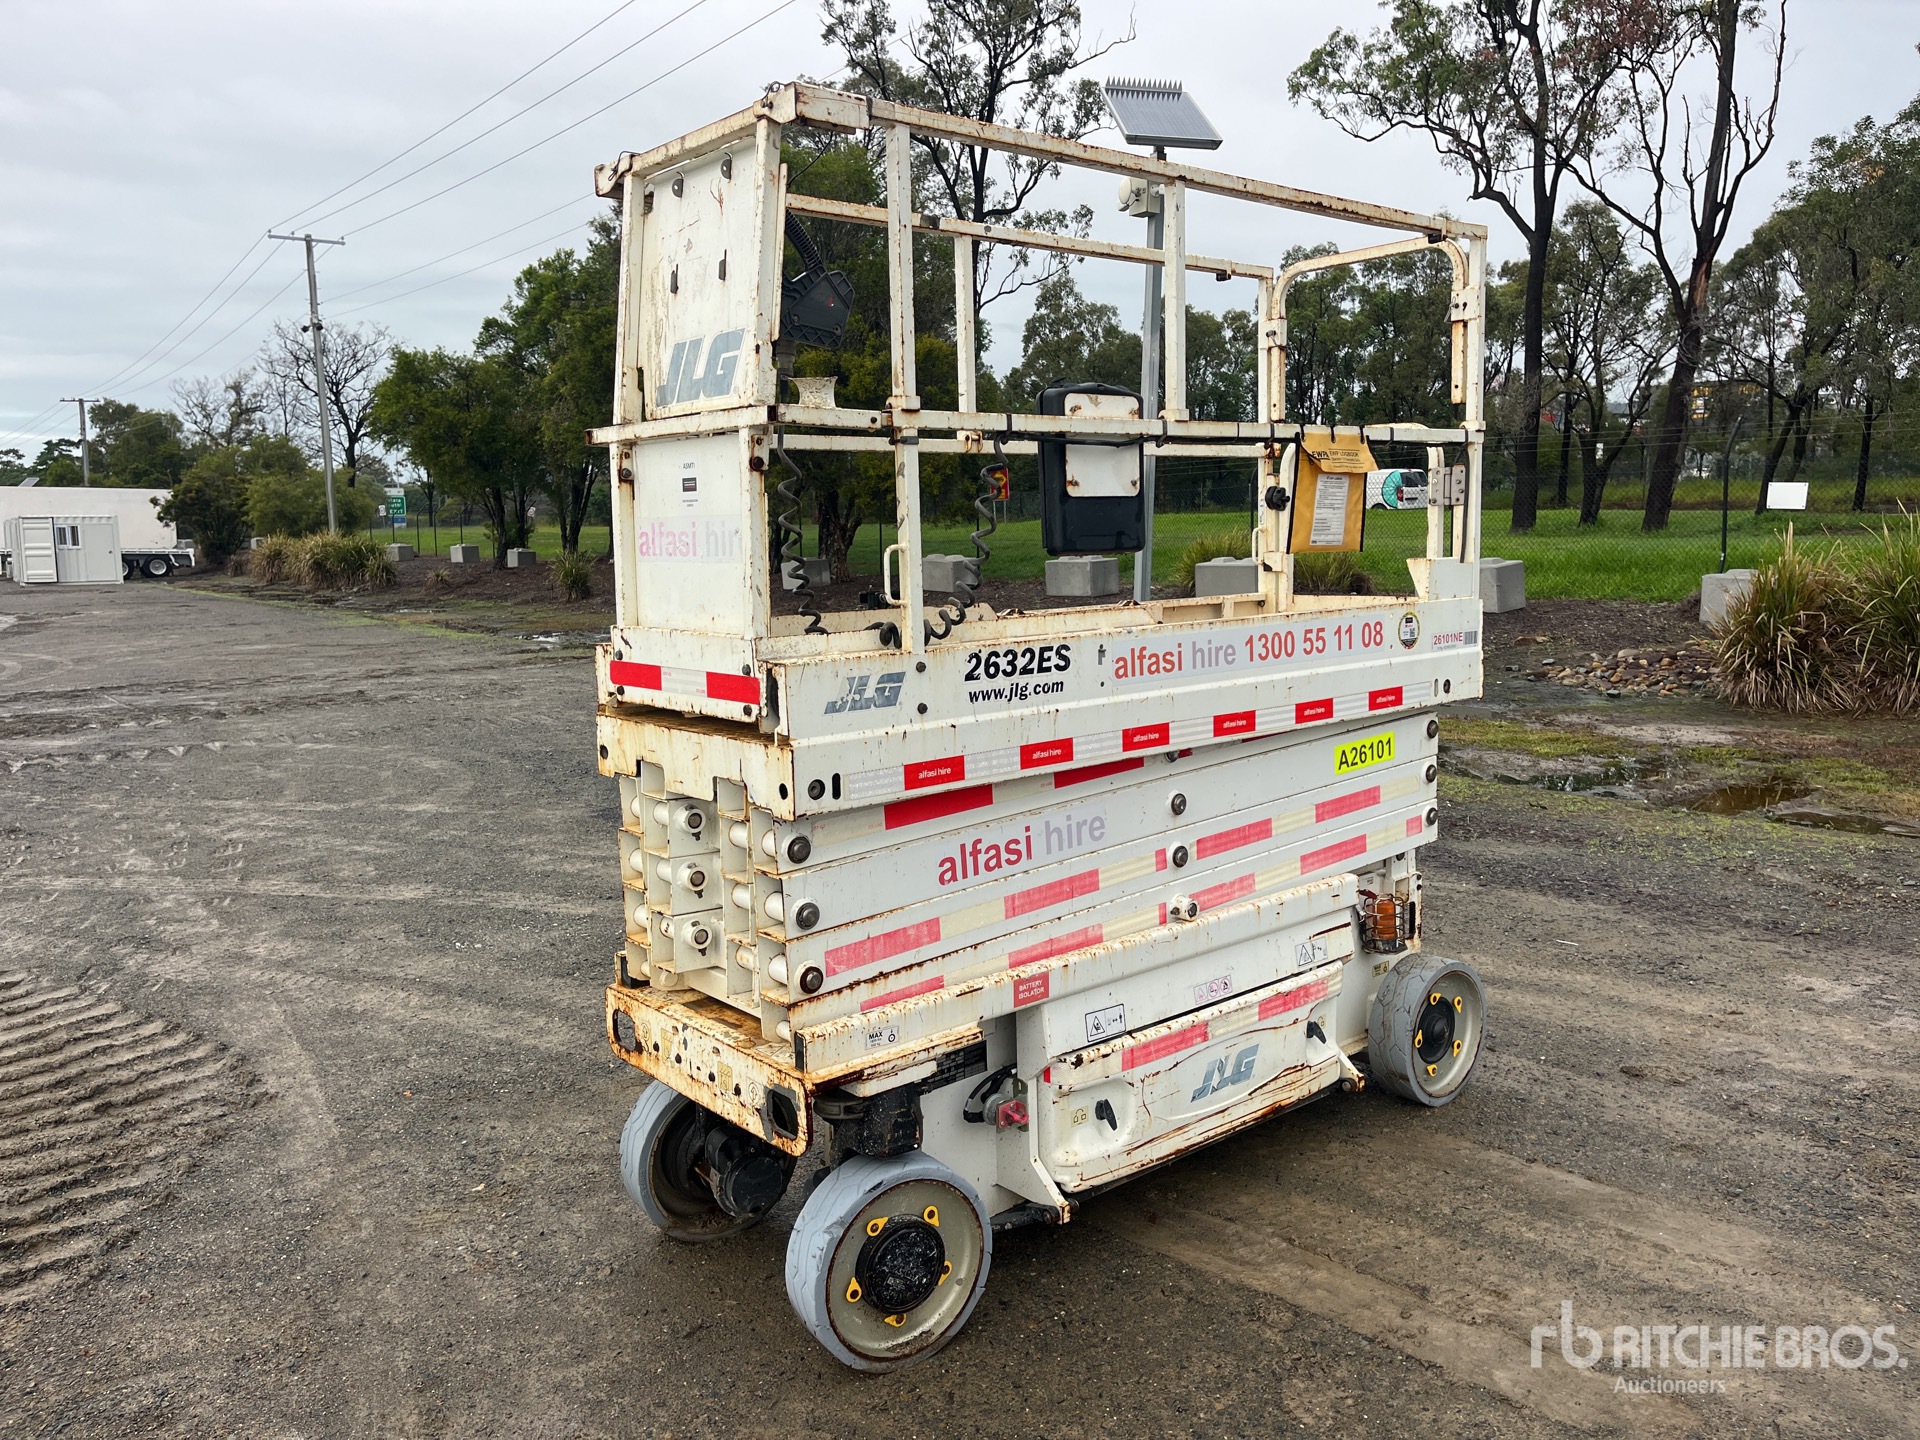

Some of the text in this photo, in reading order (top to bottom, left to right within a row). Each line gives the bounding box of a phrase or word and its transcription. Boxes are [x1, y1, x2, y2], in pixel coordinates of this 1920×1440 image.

[656, 328, 745, 407] JLG
[639, 521, 697, 557] alfasi
[1114, 643, 1183, 679] alfasi
[1191, 640, 1237, 669] hire
[1245, 631, 1295, 662] 1300
[1303, 627, 1326, 655] 55
[1333, 624, 1353, 651] 11
[1361, 621, 1384, 648] 08
[1433, 631, 1463, 646] 26101NE
[964, 644, 1071, 681] 2632ES
[824, 671, 906, 715] JLG
[968, 681, 1064, 703] www.jlg.com
[1133, 732, 1159, 743] alfasi hire
[1032, 748, 1061, 760] alfasi hire
[1338, 737, 1392, 771] A26101
[918, 766, 951, 779] alfasi hire
[938, 814, 1106, 886] alfasi hire
[1018, 987, 1045, 999] ISOLATOR
[1019, 980, 1043, 991] BATTERY
[868, 1031, 883, 1040] MAX
[1191, 1044, 1260, 1103] JLG
